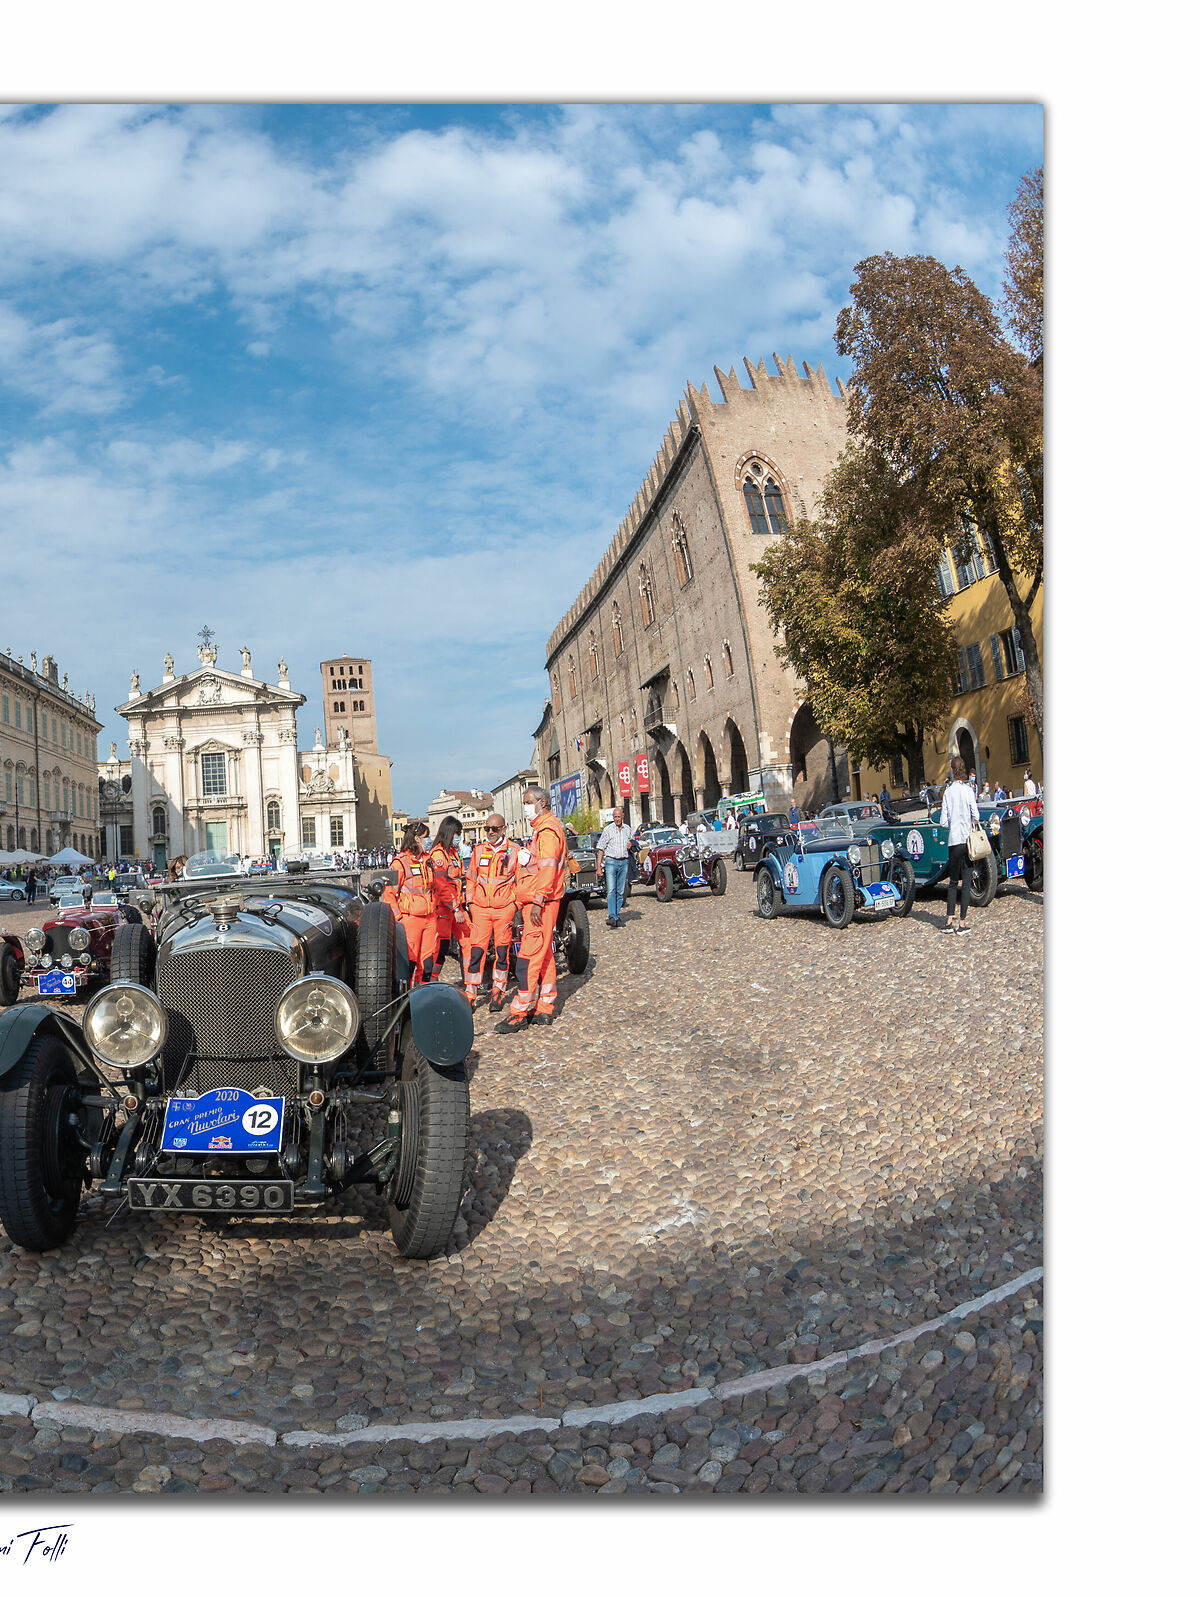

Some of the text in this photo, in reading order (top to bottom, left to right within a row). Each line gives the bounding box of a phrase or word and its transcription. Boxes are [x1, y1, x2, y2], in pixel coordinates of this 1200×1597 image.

[215, 1090, 240, 1102] 2020
[187, 1109, 240, 1135] Nuvolari
[194, 1106, 223, 1121] PREMIO
[248, 1110, 272, 1129] 12
[136, 1183, 285, 1208] YX 6390
